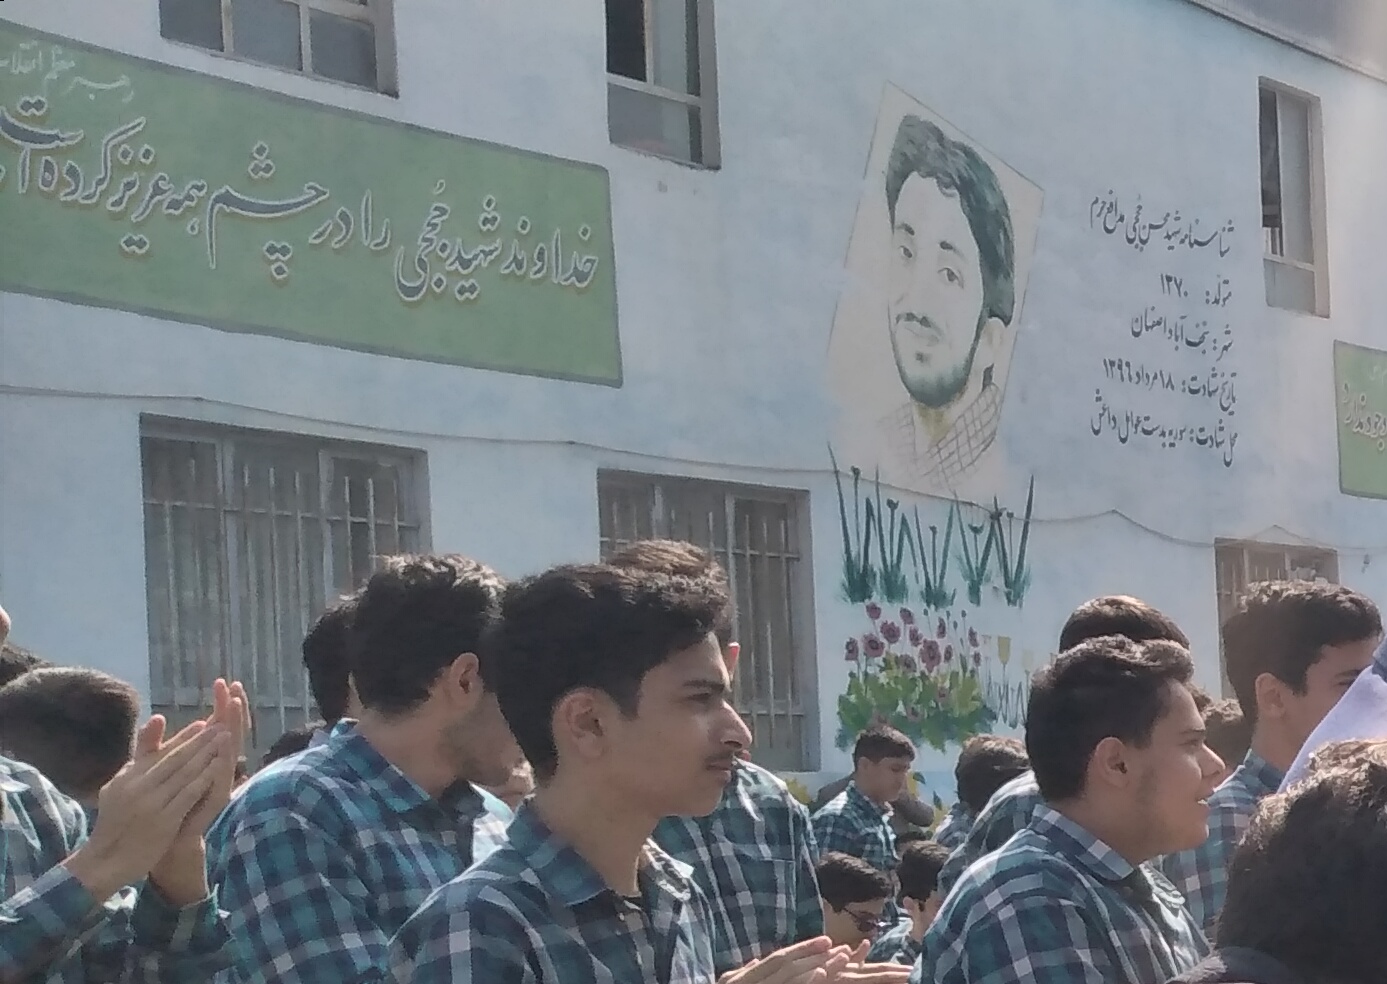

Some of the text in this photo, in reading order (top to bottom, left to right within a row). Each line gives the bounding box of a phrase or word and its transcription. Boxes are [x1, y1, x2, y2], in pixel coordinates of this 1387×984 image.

[38, 116, 147, 204] کرده
[108, 144, 170, 255] عزیز
[163, 179, 208, 236] همه
[206, 141, 330, 281] چشم
[360, 189, 392, 251] را
[1090, 196, 1107, 229] حرم
[1102, 189, 1125, 235] مدافع
[308, 206, 355, 249] در
[446, 196, 503, 300] شهید
[1138, 211, 1171, 246] محسن
[1163, 210, 1182, 251] شهید
[1179, 217, 1235, 258] شناسنامه
[500, 218, 600, 289] خداوند
[1159, 272, 1189, 298] ۱۳۷۰
[1131, 305, 1167, 338] اصفهان
[1090, 388, 1118, 437] داعش
[1218, 371, 1238, 417] تاریخ
